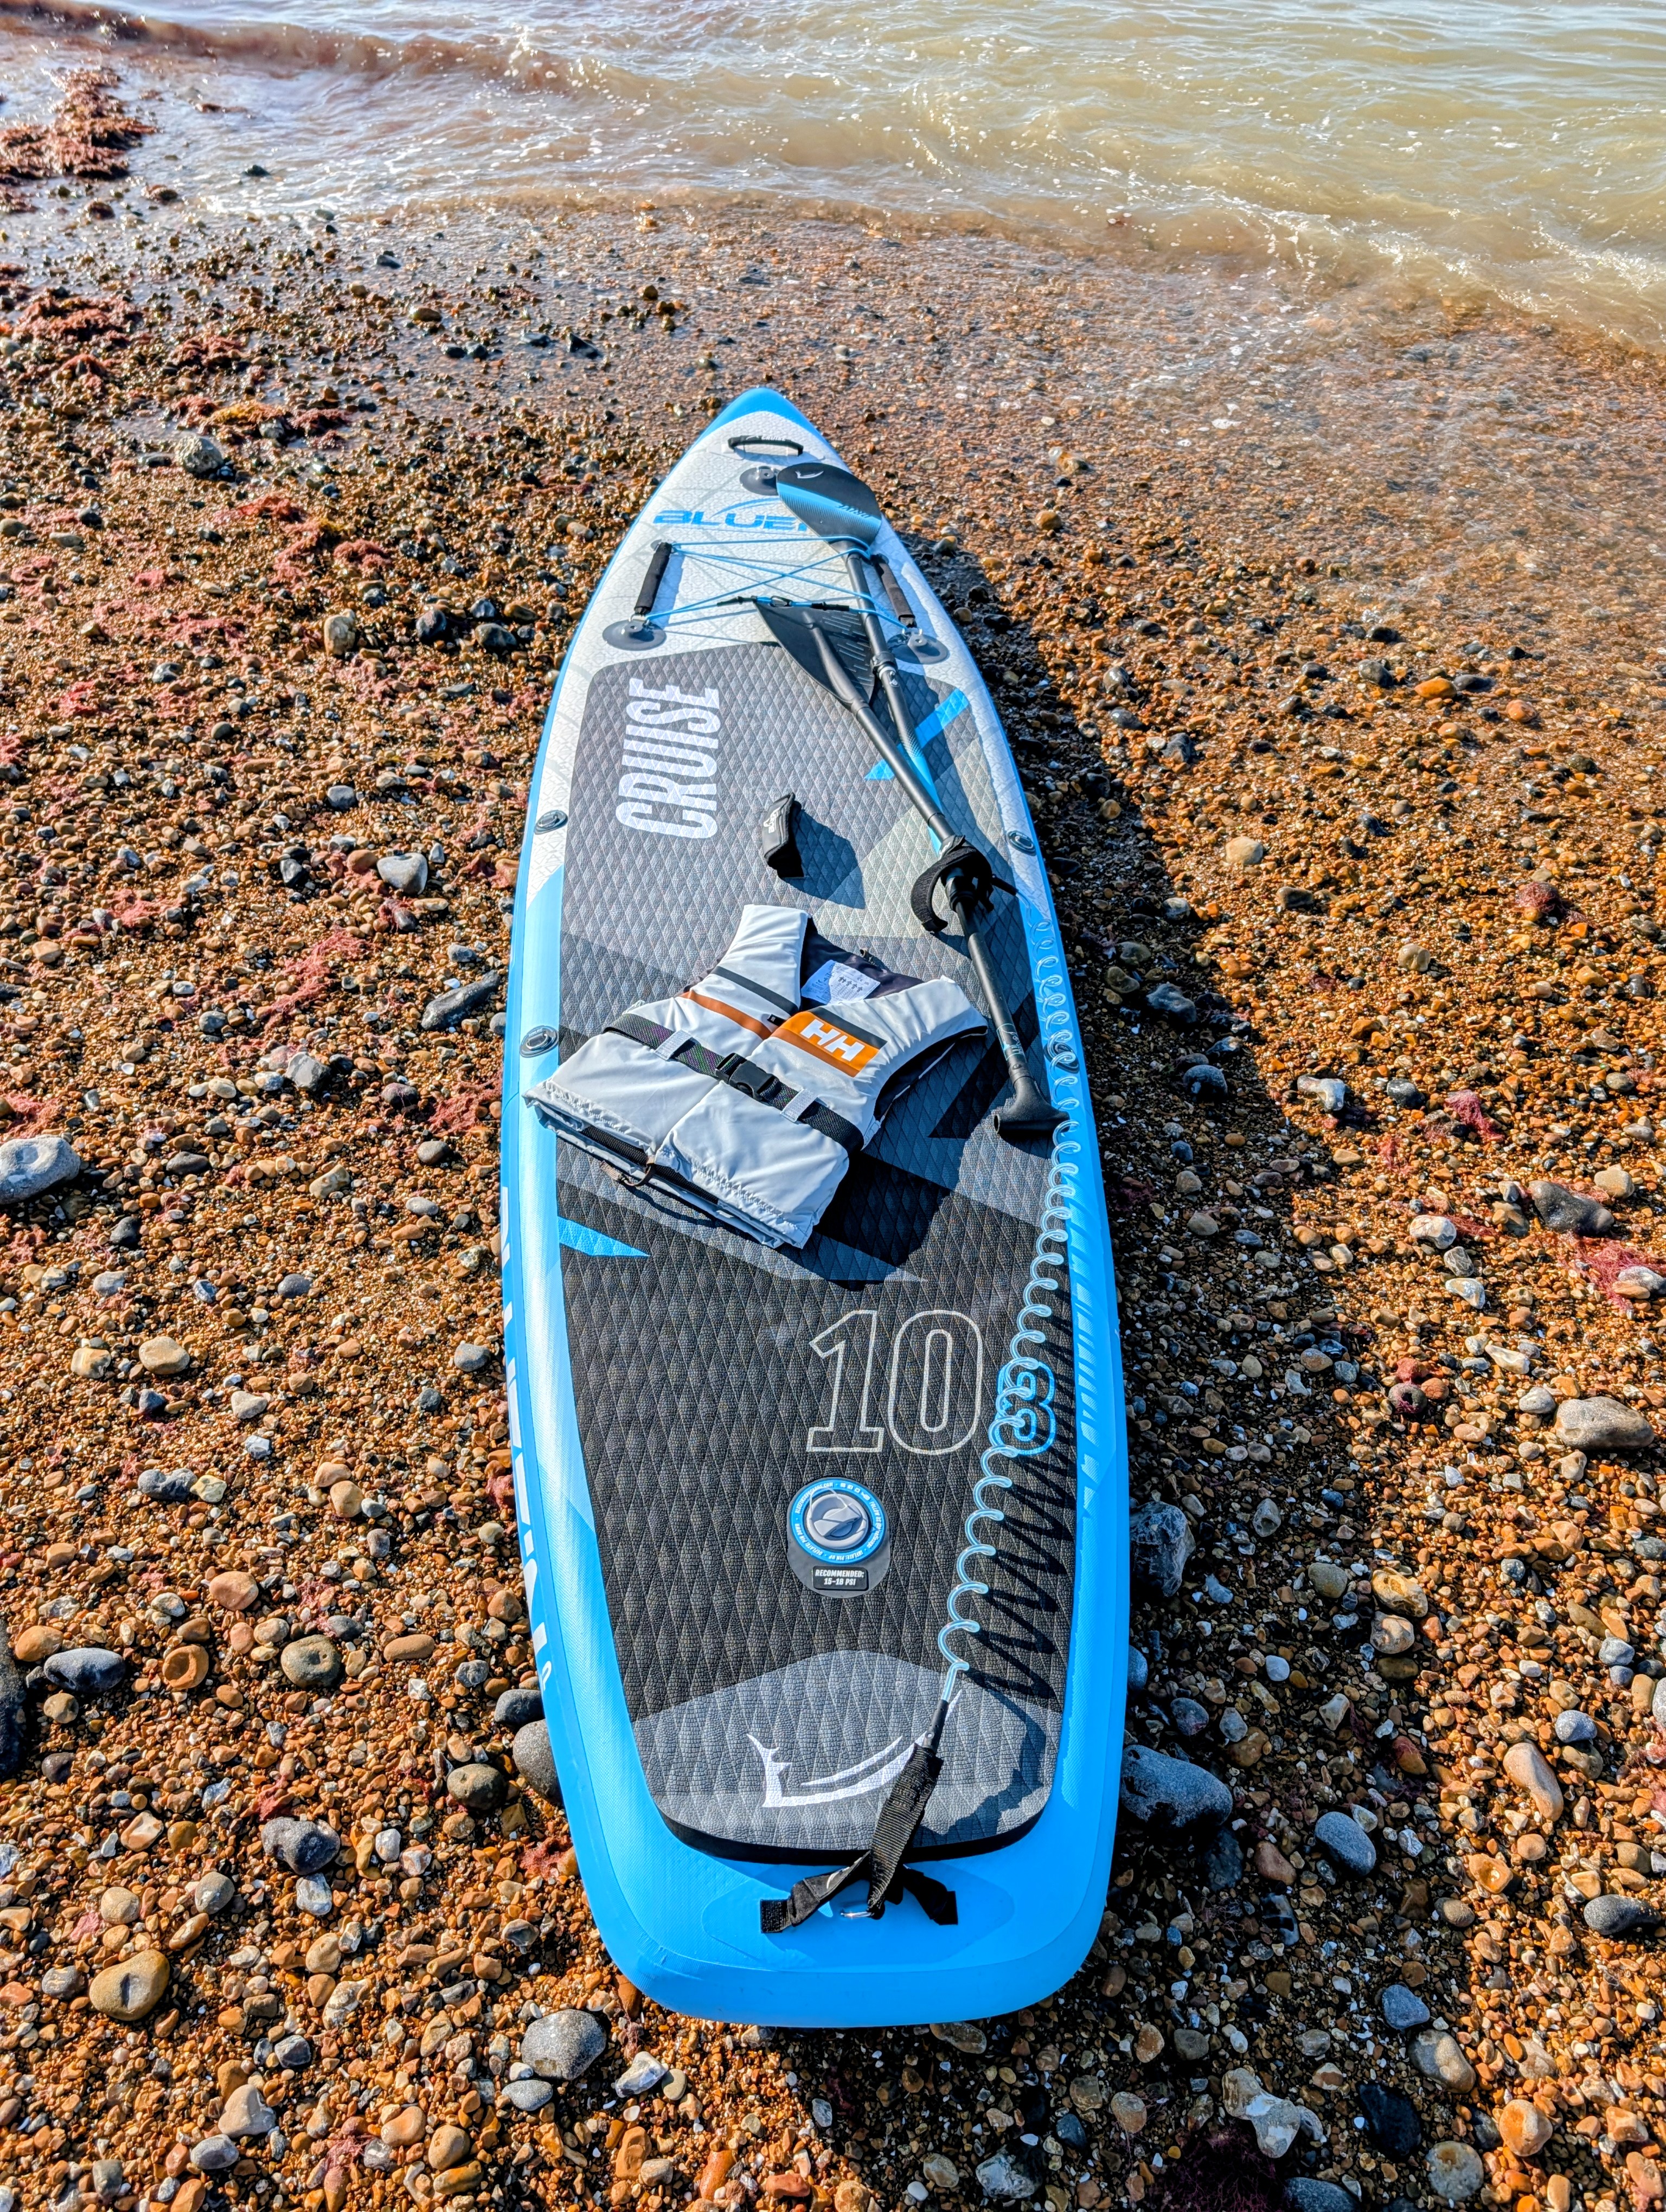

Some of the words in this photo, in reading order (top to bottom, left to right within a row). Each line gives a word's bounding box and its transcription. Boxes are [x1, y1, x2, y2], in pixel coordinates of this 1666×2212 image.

[653, 510, 807, 531] BLUE
[616, 678, 721, 838] CRUISE
[800, 1018, 866, 1062] HH
[869, 1501, 881, 1516] FOLLOW
[815, 1569, 864, 1578] RECOMMENDED:
